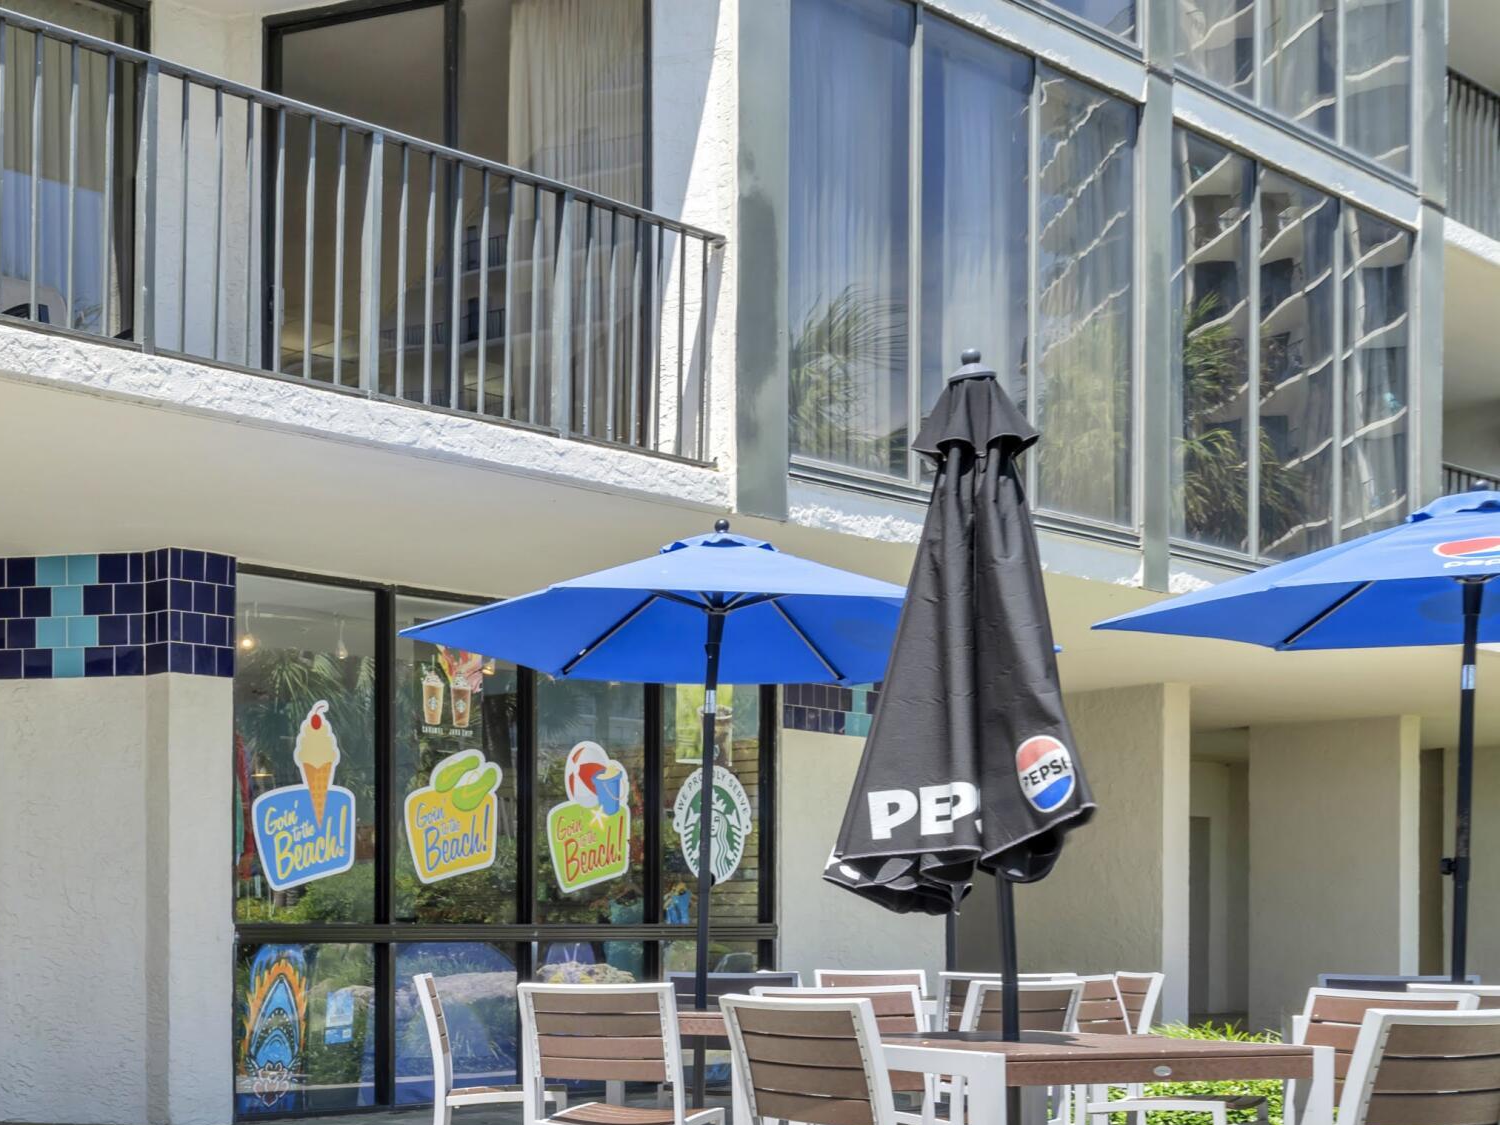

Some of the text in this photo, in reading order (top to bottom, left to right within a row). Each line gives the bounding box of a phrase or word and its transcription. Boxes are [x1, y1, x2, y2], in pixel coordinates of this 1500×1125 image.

[677, 792, 687, 810] WE
[688, 770, 726, 791] PRLY
[275, 805, 347, 879] Beach!
[424, 804, 490, 871] Beach!
[564, 816, 623, 881] Beach!
